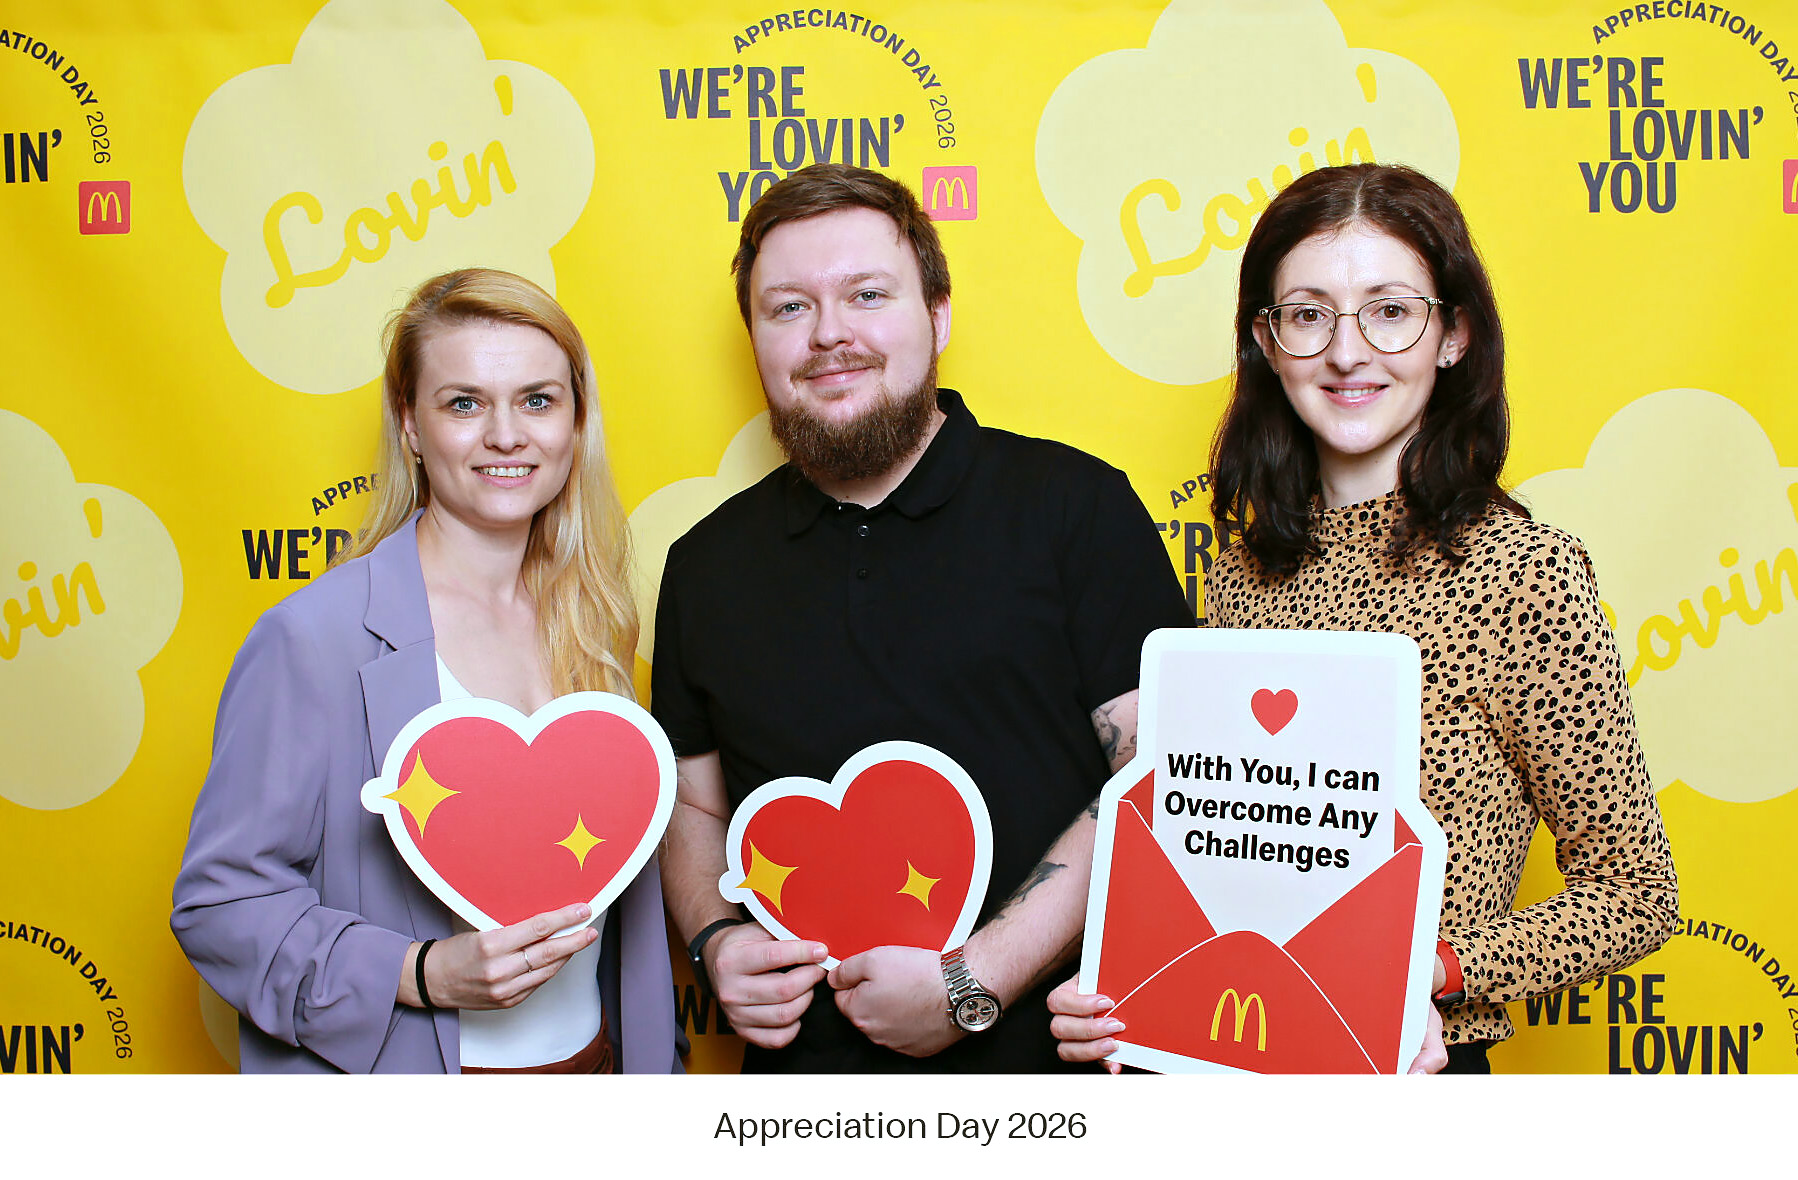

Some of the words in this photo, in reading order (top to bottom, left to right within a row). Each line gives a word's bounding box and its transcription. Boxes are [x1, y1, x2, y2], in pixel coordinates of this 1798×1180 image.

[1592, 0, 1763, 45] APPRECIATION
[1759, 40, 1798, 83] DAY
[659, 64, 806, 119] WE’RE
[733, 8, 905, 54] APPRECIATION
[901, 47, 942, 91] DAY
[929, 94, 956, 149] 2026
[1518, 54, 1665, 109] WE’RE
[61, 65, 98, 106] DAY
[86, 111, 111, 164] 2026
[749, 113, 905, 170] LOVIN’
[1609, 105, 1764, 161] LOVIN’
[262, 74, 517, 309] Lovin'
[1578, 161, 1677, 214] YOU
[1167, 752, 1232, 782] With
[1240, 757, 1300, 791] You,
[1308, 762, 1316, 787] I
[1324, 769, 1380, 792] can
[1165, 790, 1312, 826] Overcome
[1318, 802, 1378, 839] Any
[1184, 829, 1350, 873] Challenges
[1525, 973, 1666, 1026] WE’RE
[1760, 957, 1798, 1001] DAY
[79, 960, 118, 1002] DAY
[107, 1007, 133, 1059] 2026
[1608, 1022, 1764, 1074] LOVIN’
